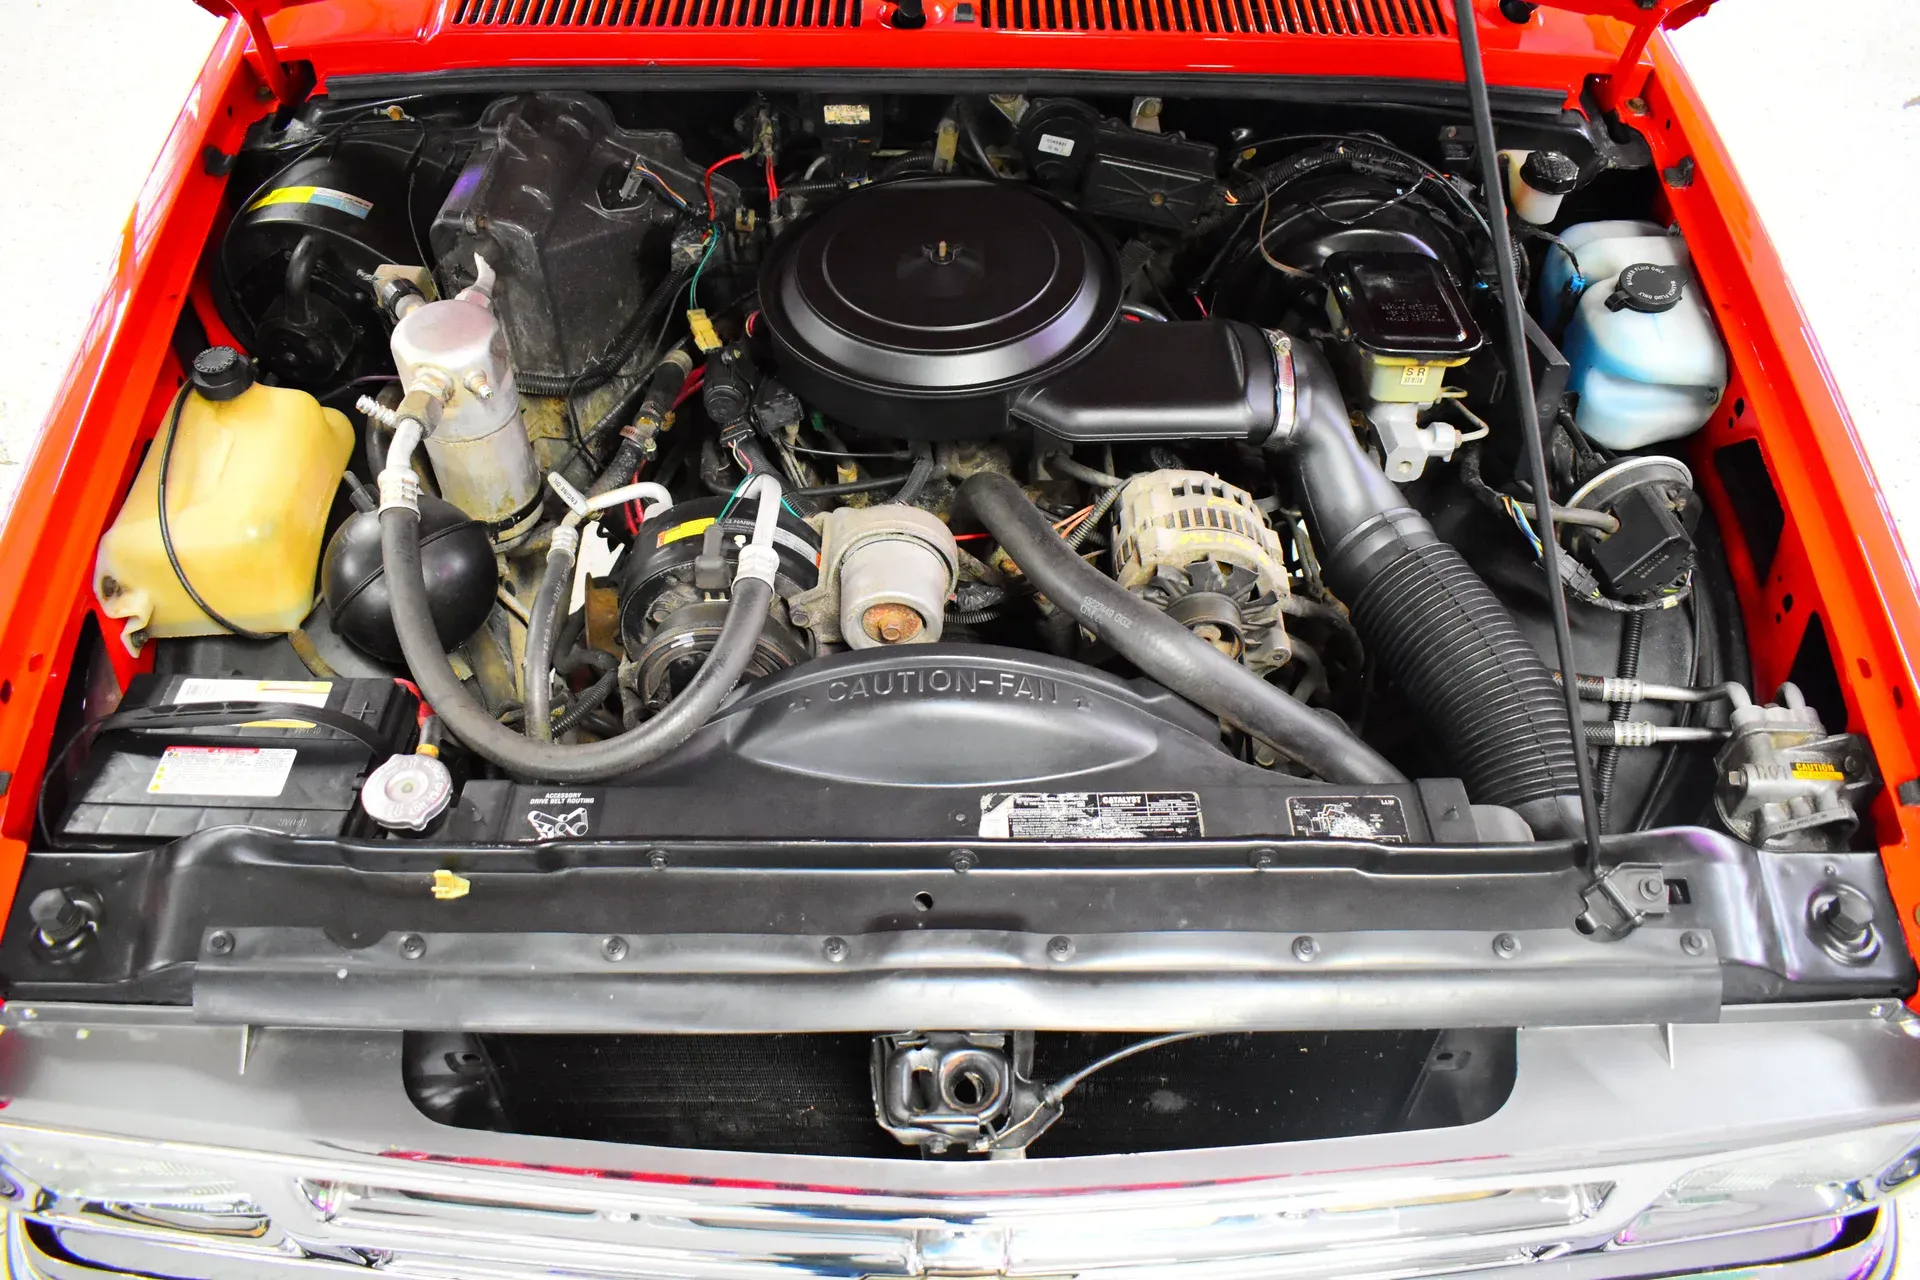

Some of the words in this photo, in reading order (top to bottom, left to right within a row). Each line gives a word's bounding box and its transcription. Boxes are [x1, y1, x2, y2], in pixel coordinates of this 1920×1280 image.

[1651, 266, 1666, 274] ONLY
[1638, 291, 1653, 300] ONLY
[553, 478, 562, 488] OIL
[560, 486, 579, 506] ENGINE
[1795, 762, 1835, 772] CAUTION
[1102, 795, 1142, 804] CATALYST
